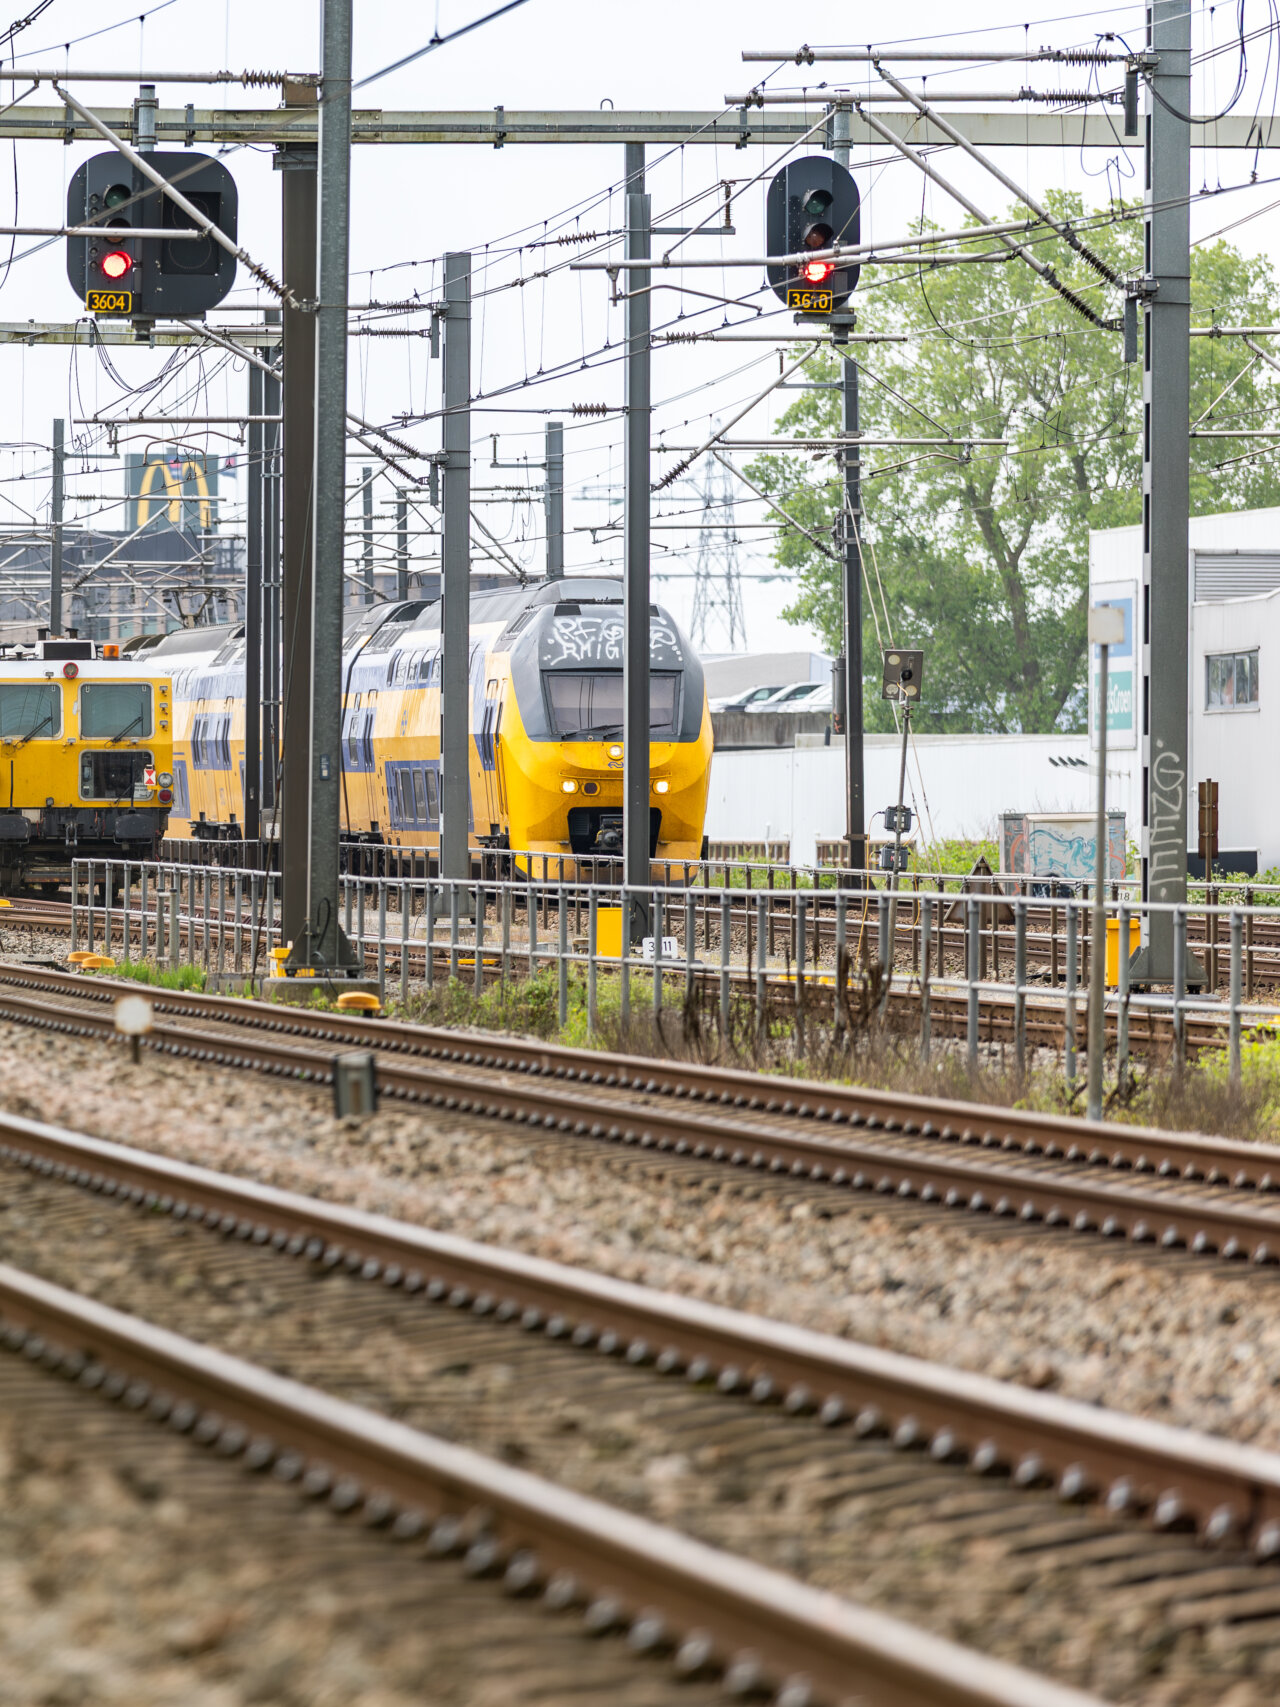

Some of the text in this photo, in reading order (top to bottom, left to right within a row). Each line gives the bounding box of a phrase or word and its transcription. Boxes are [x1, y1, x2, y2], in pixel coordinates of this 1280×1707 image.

[91, 293, 126, 311] 3604
[791, 292, 829, 309] 3610
[648, 940, 673, 953] 311
